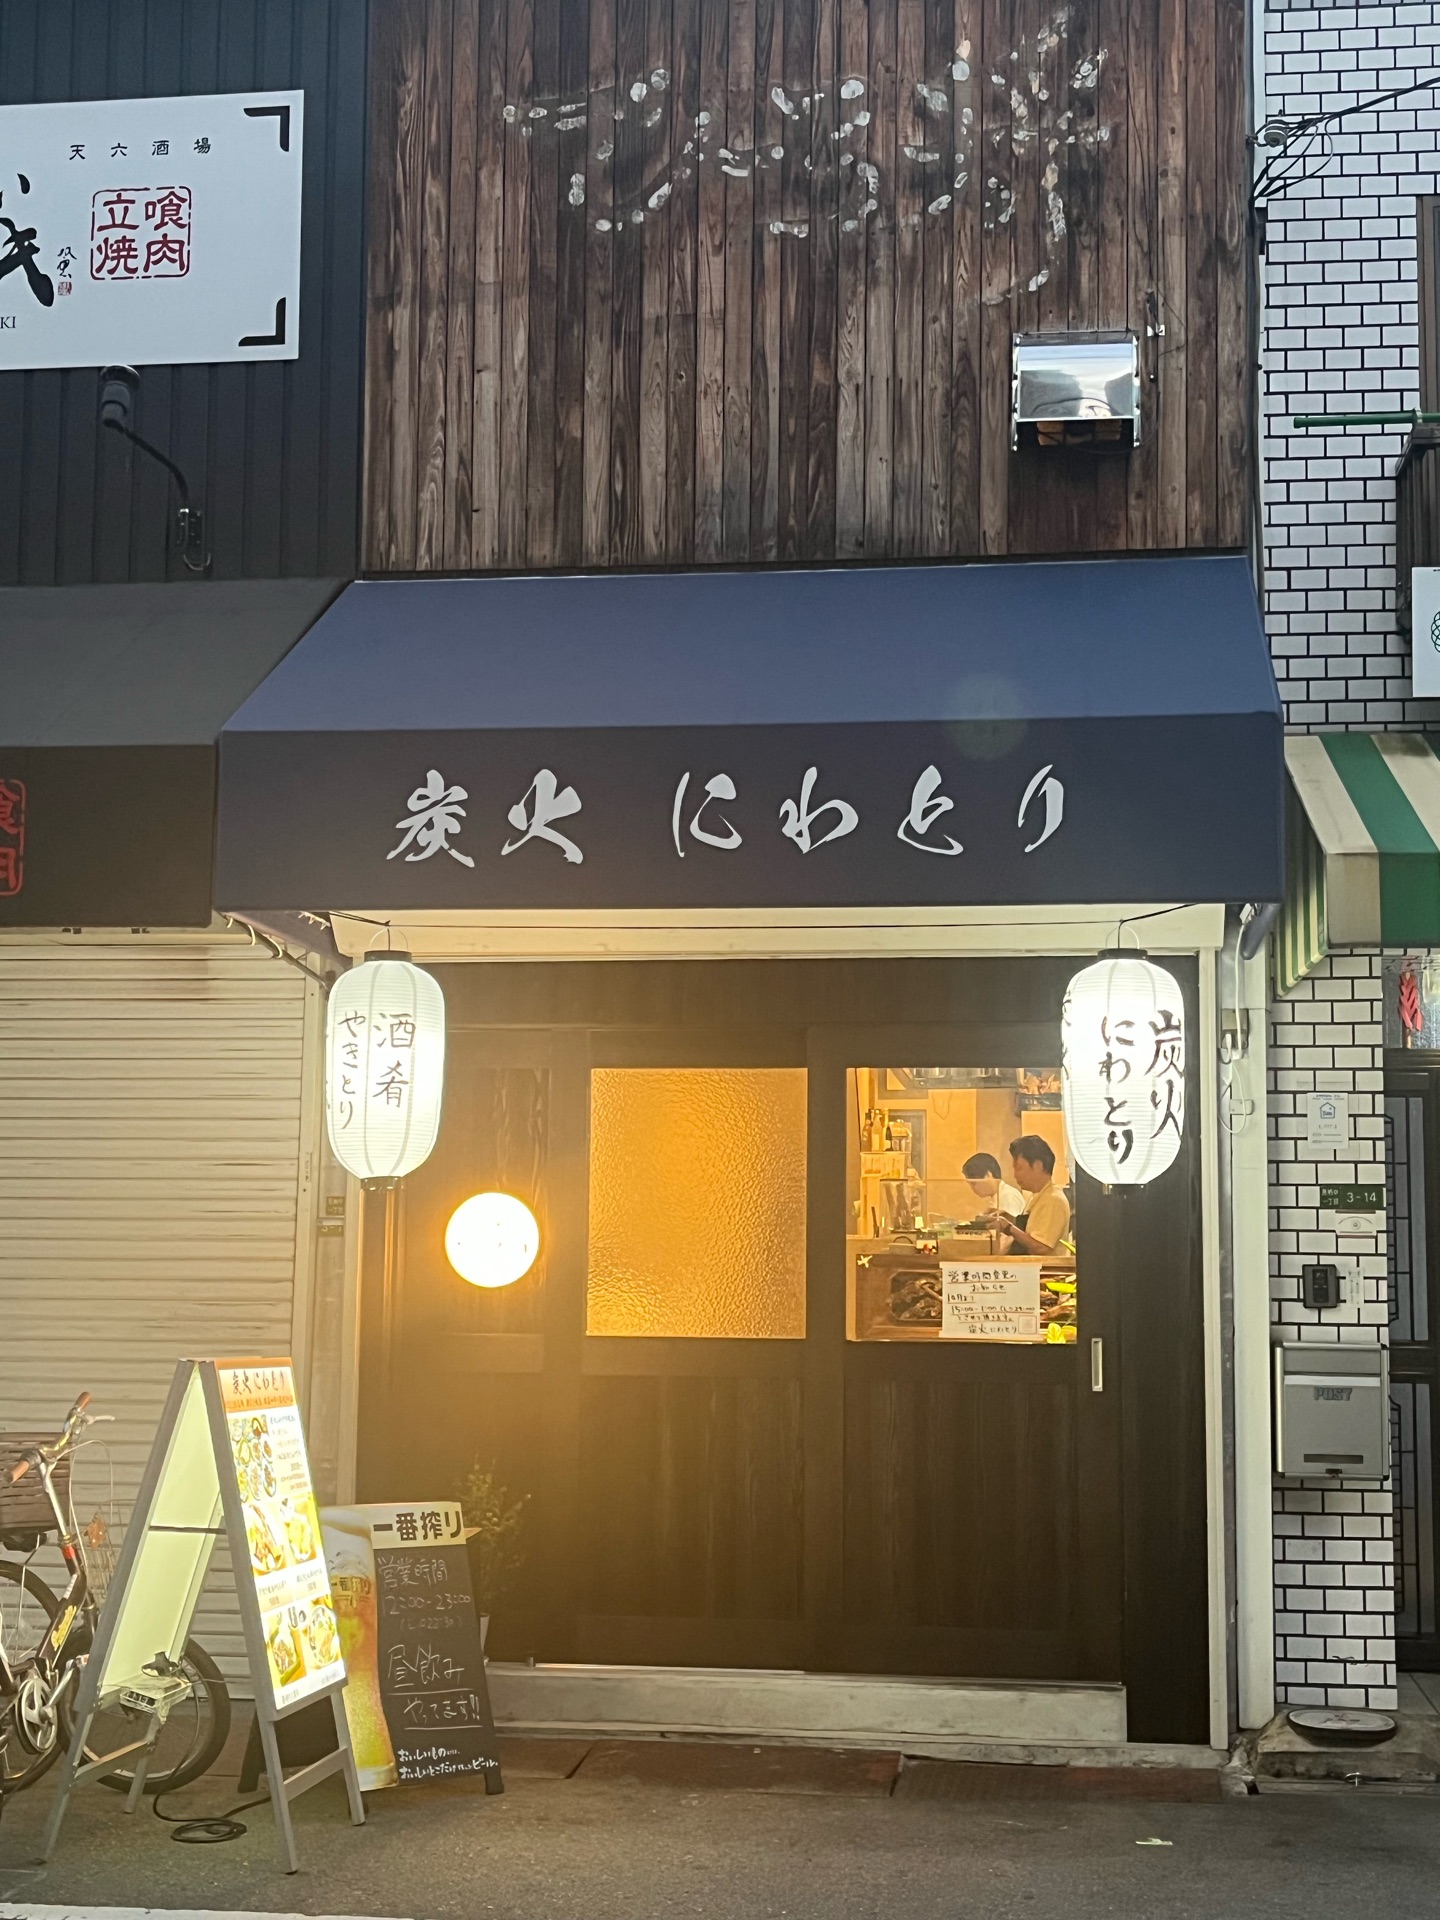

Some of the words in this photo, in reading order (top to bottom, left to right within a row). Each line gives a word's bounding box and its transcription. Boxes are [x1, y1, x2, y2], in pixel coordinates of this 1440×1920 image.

[69, 137, 212, 161] 天六酒場
[386, 768, 583, 868] 炭火
[672, 764, 1065, 858] にわとり
[337, 1010, 366, 1130] やきとり
[372, 1012, 416, 1109] 酒肴
[1098, 1015, 1136, 1165] にわとり
[1346, 1191, 1377, 1203] 3-14
[1313, 1387, 1353, 1401] POST
[373, 1510, 462, 1541] 一番搾り
[378, 1555, 448, 1588] 営業時間
